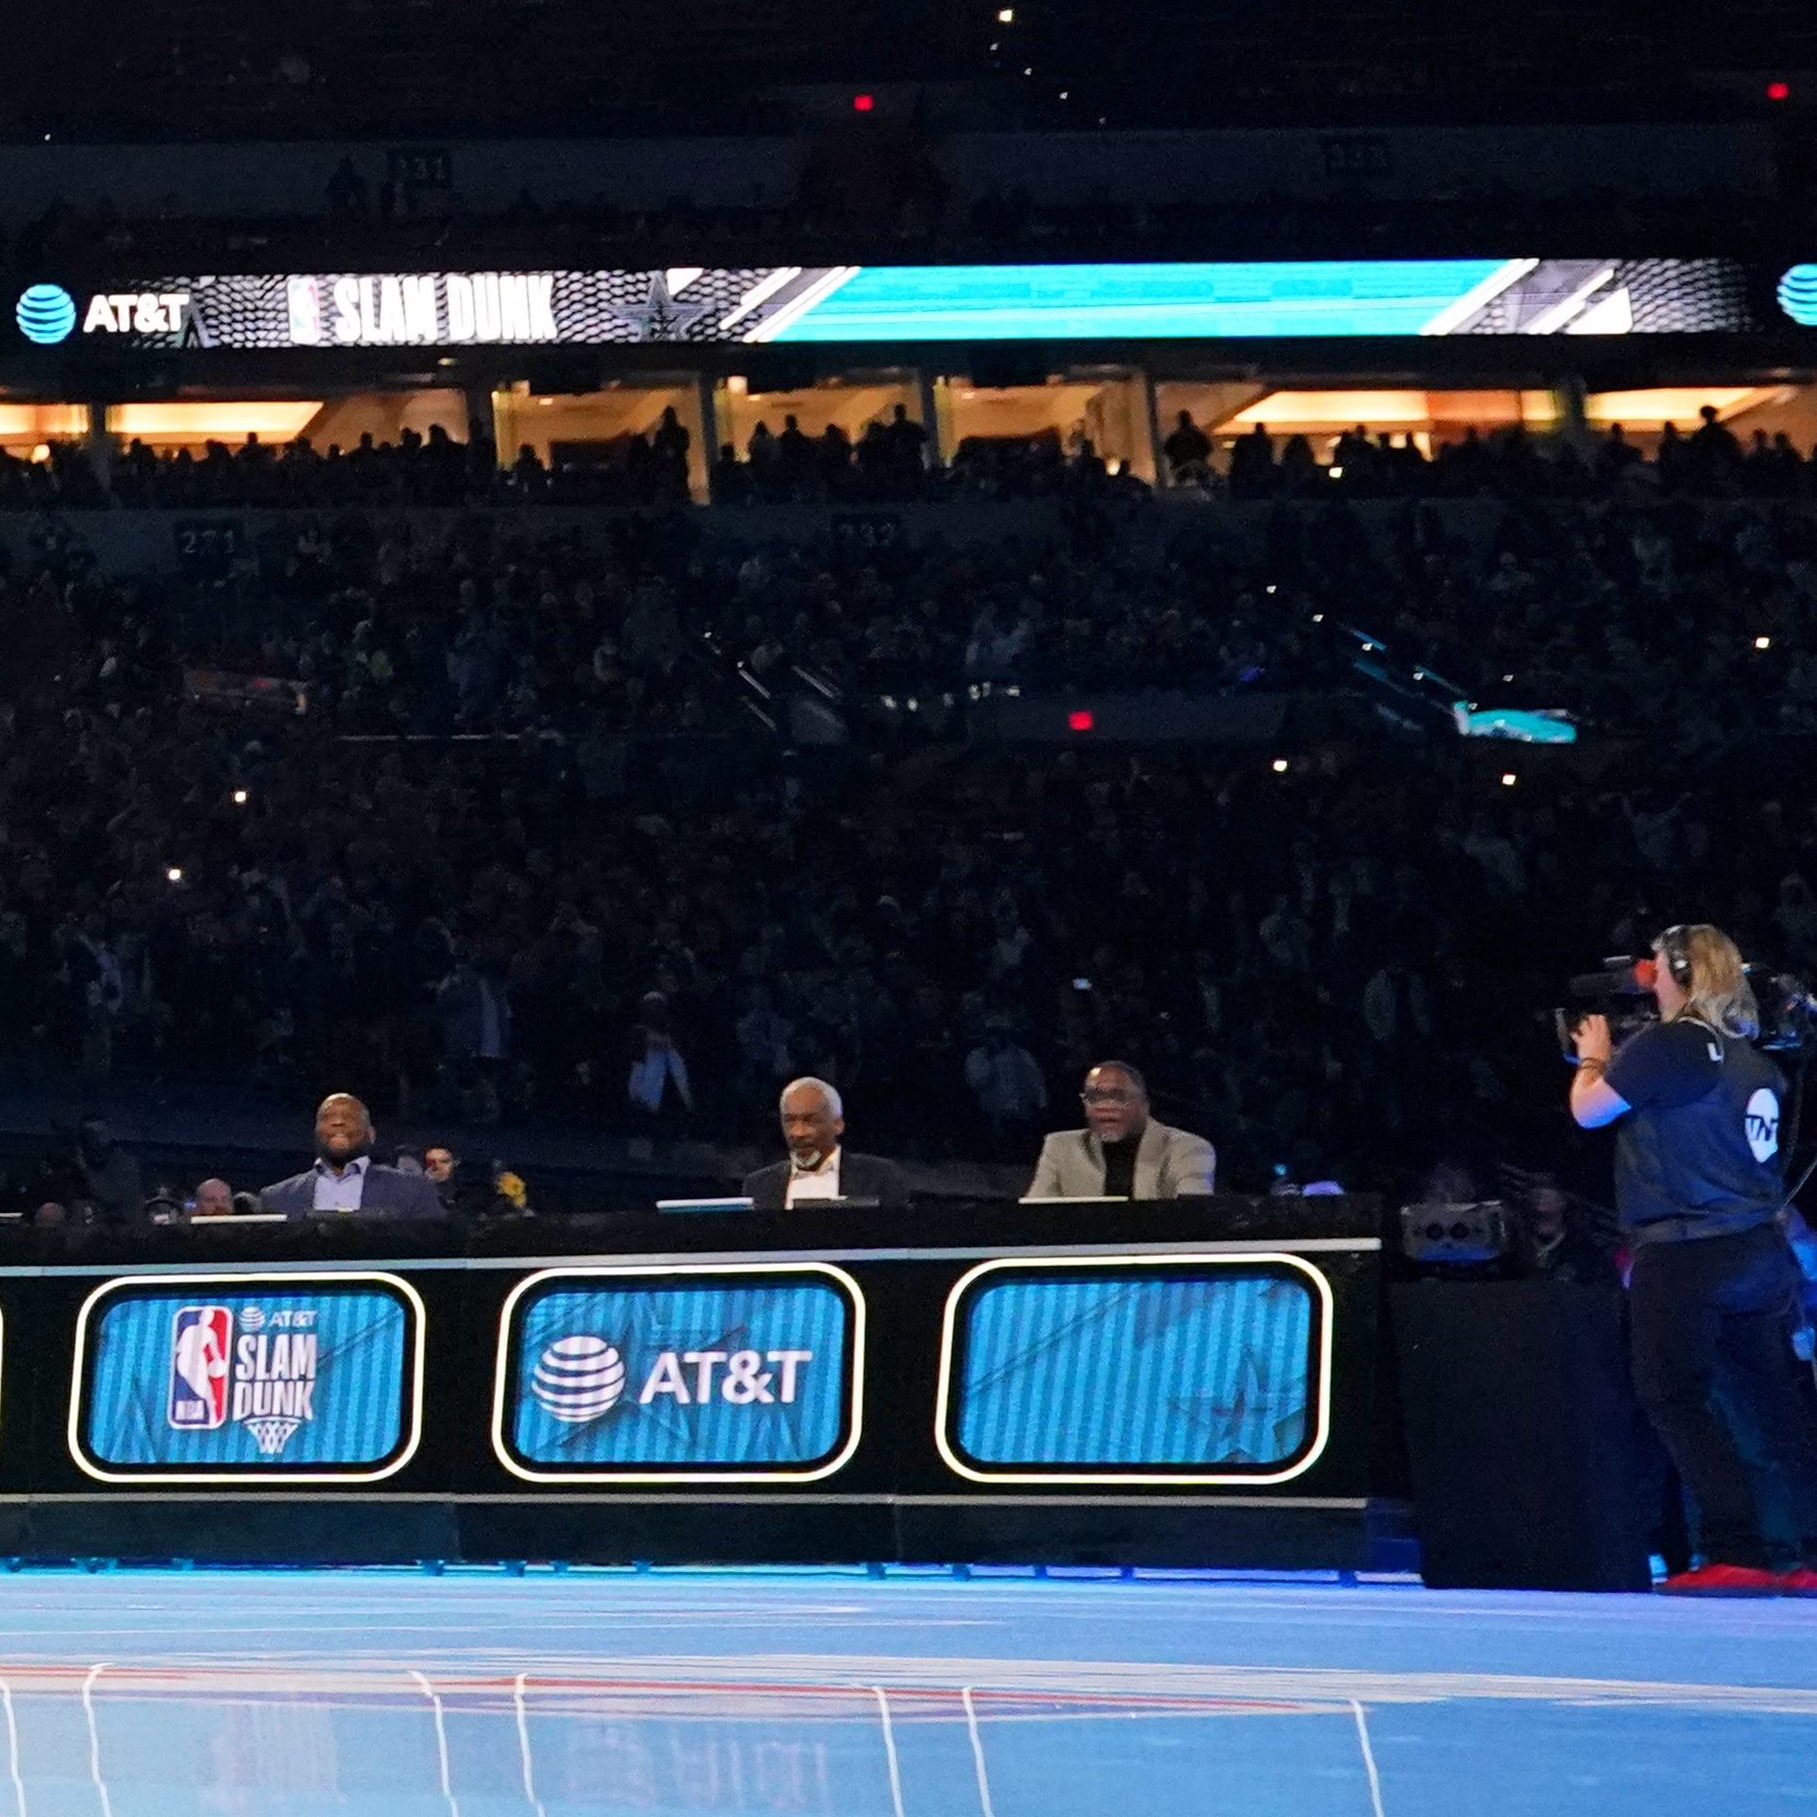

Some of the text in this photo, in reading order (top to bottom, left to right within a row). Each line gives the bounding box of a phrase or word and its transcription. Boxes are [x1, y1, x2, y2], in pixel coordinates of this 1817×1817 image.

[83, 294, 191, 333] AT&T
[334, 274, 558, 342] SLAM DUNK
[269, 1310, 318, 1328] AT&T
[234, 1334, 317, 1381] SLAM
[639, 1350, 813, 1404] AT&T
[232, 1380, 316, 1422] DUNK
